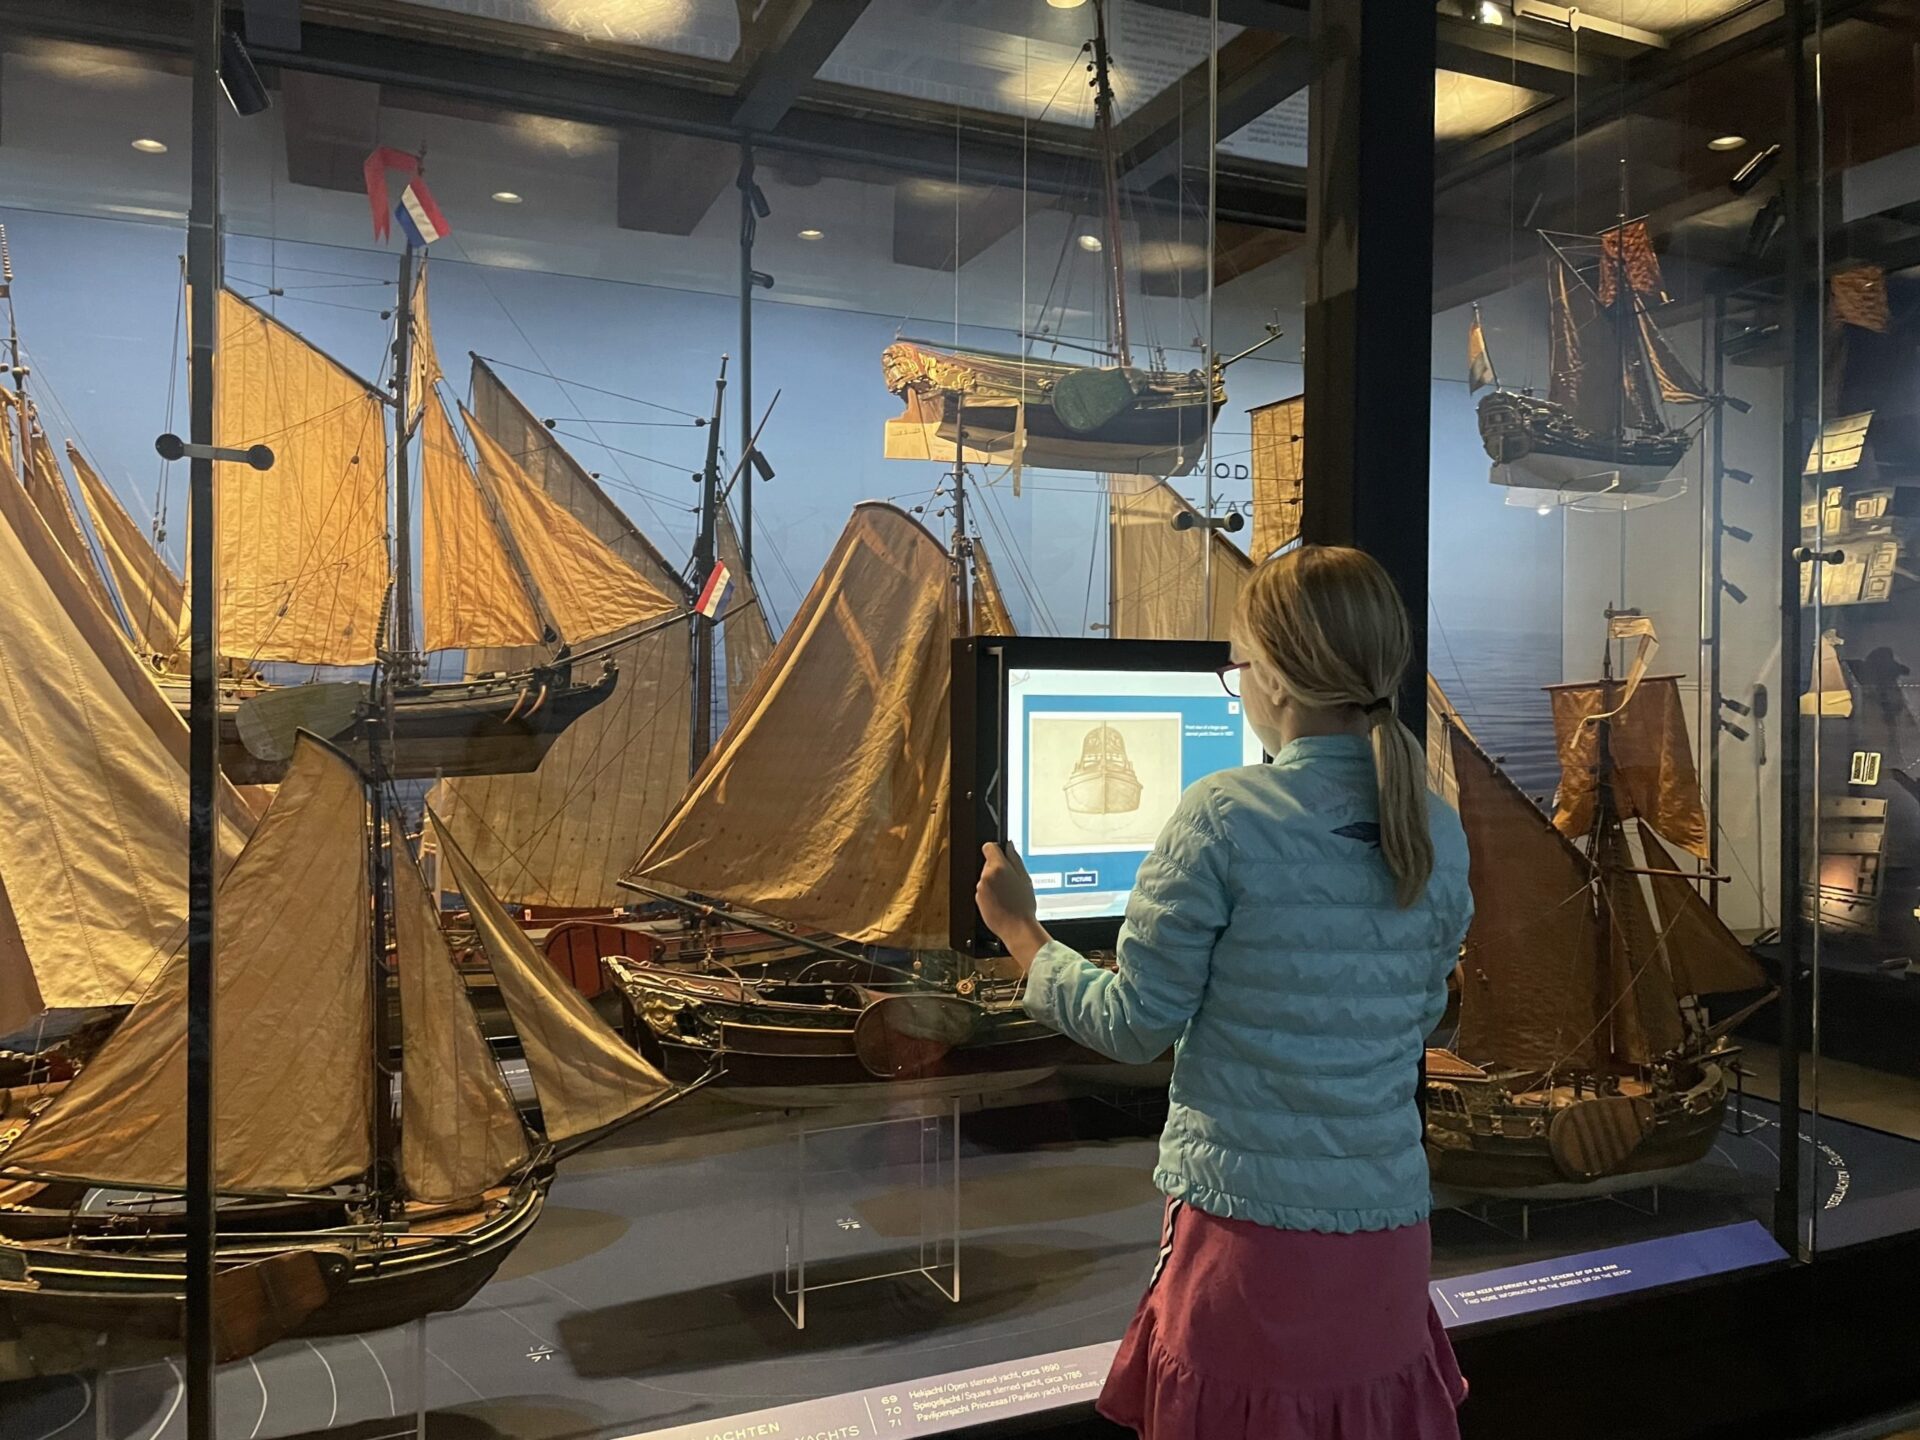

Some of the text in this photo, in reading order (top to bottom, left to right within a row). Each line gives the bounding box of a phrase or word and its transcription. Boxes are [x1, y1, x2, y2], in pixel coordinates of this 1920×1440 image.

[881, 1394, 898, 1405] 69
[1021, 1368, 1040, 1377] circa
[884, 1405, 902, 1416] 70
[1044, 1375, 1063, 1384] circa
[888, 1418, 902, 1428] 71
